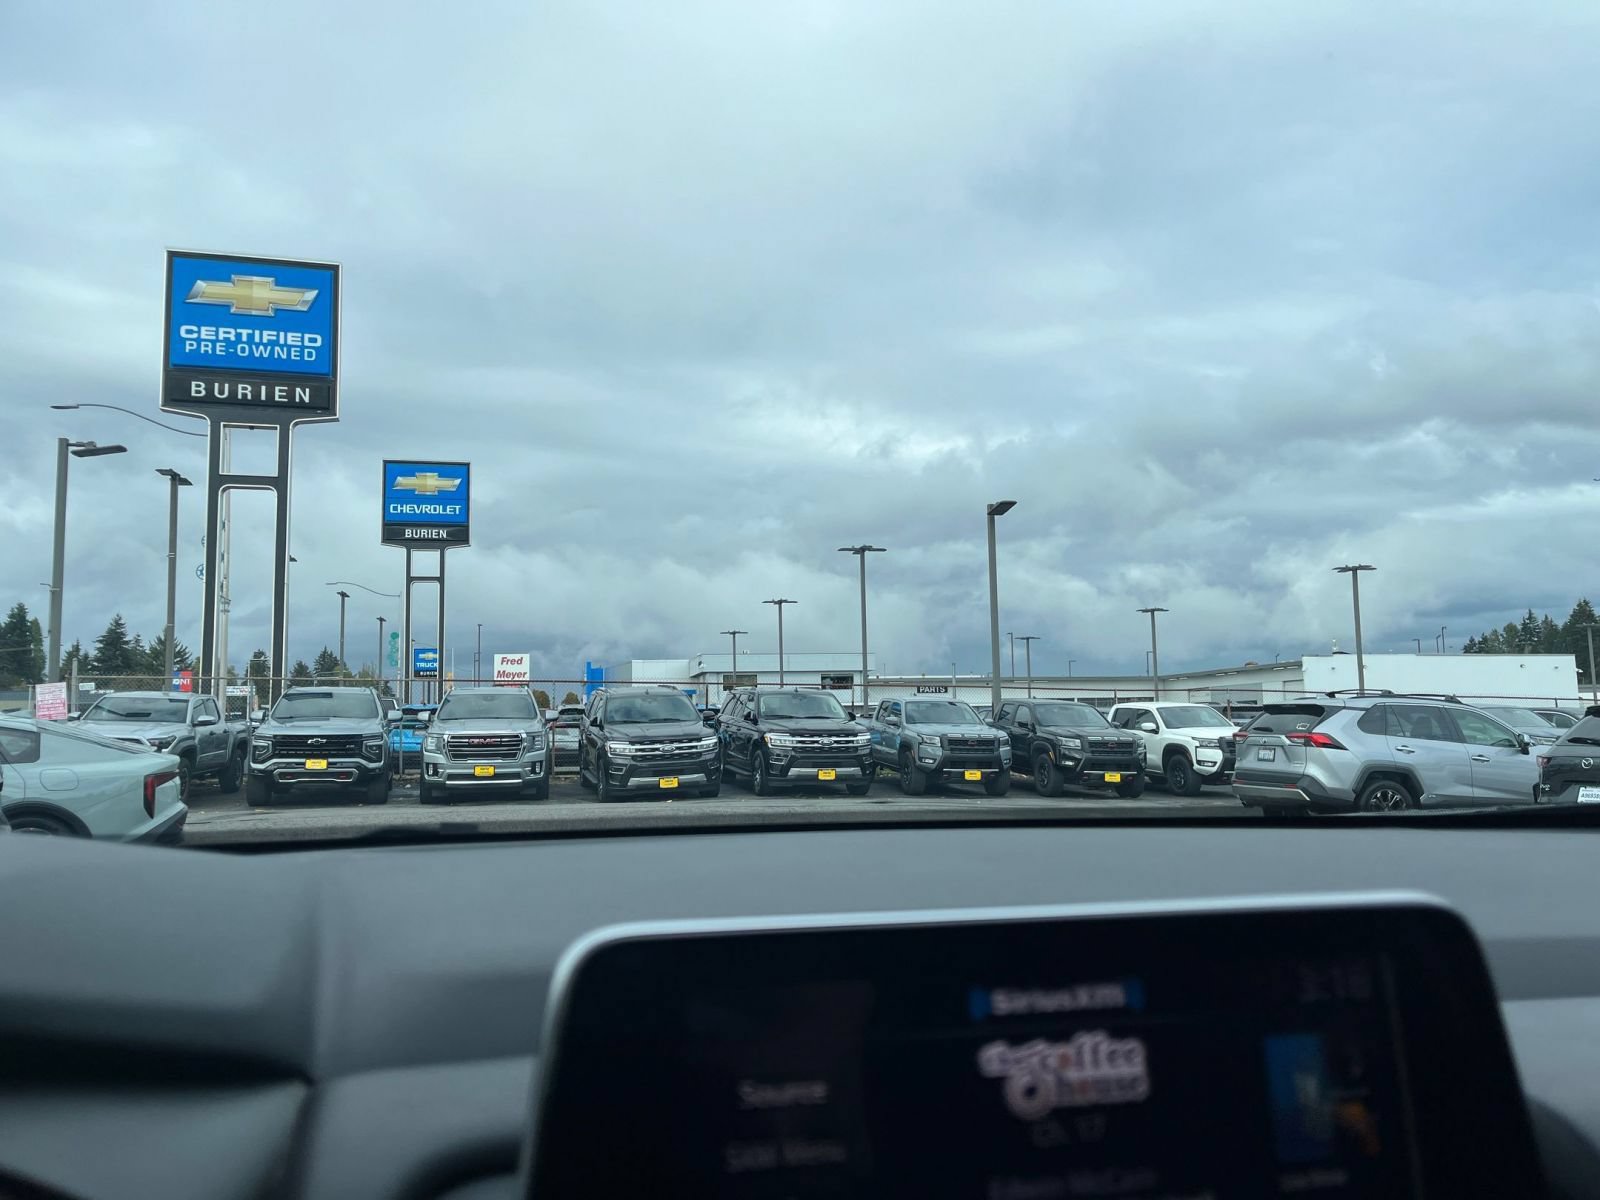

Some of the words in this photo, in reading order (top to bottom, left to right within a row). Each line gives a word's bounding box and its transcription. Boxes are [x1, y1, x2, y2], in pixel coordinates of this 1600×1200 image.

[180, 325, 322, 347] CERTIFIED
[185, 340, 316, 361] PRE-OWNED
[191, 381, 310, 403] BURIEN
[389, 503, 462, 515] CHEVROLET
[405, 529, 447, 539] BURIEN
[500, 656, 524, 666] Fred
[496, 670, 528, 680] Meyer
